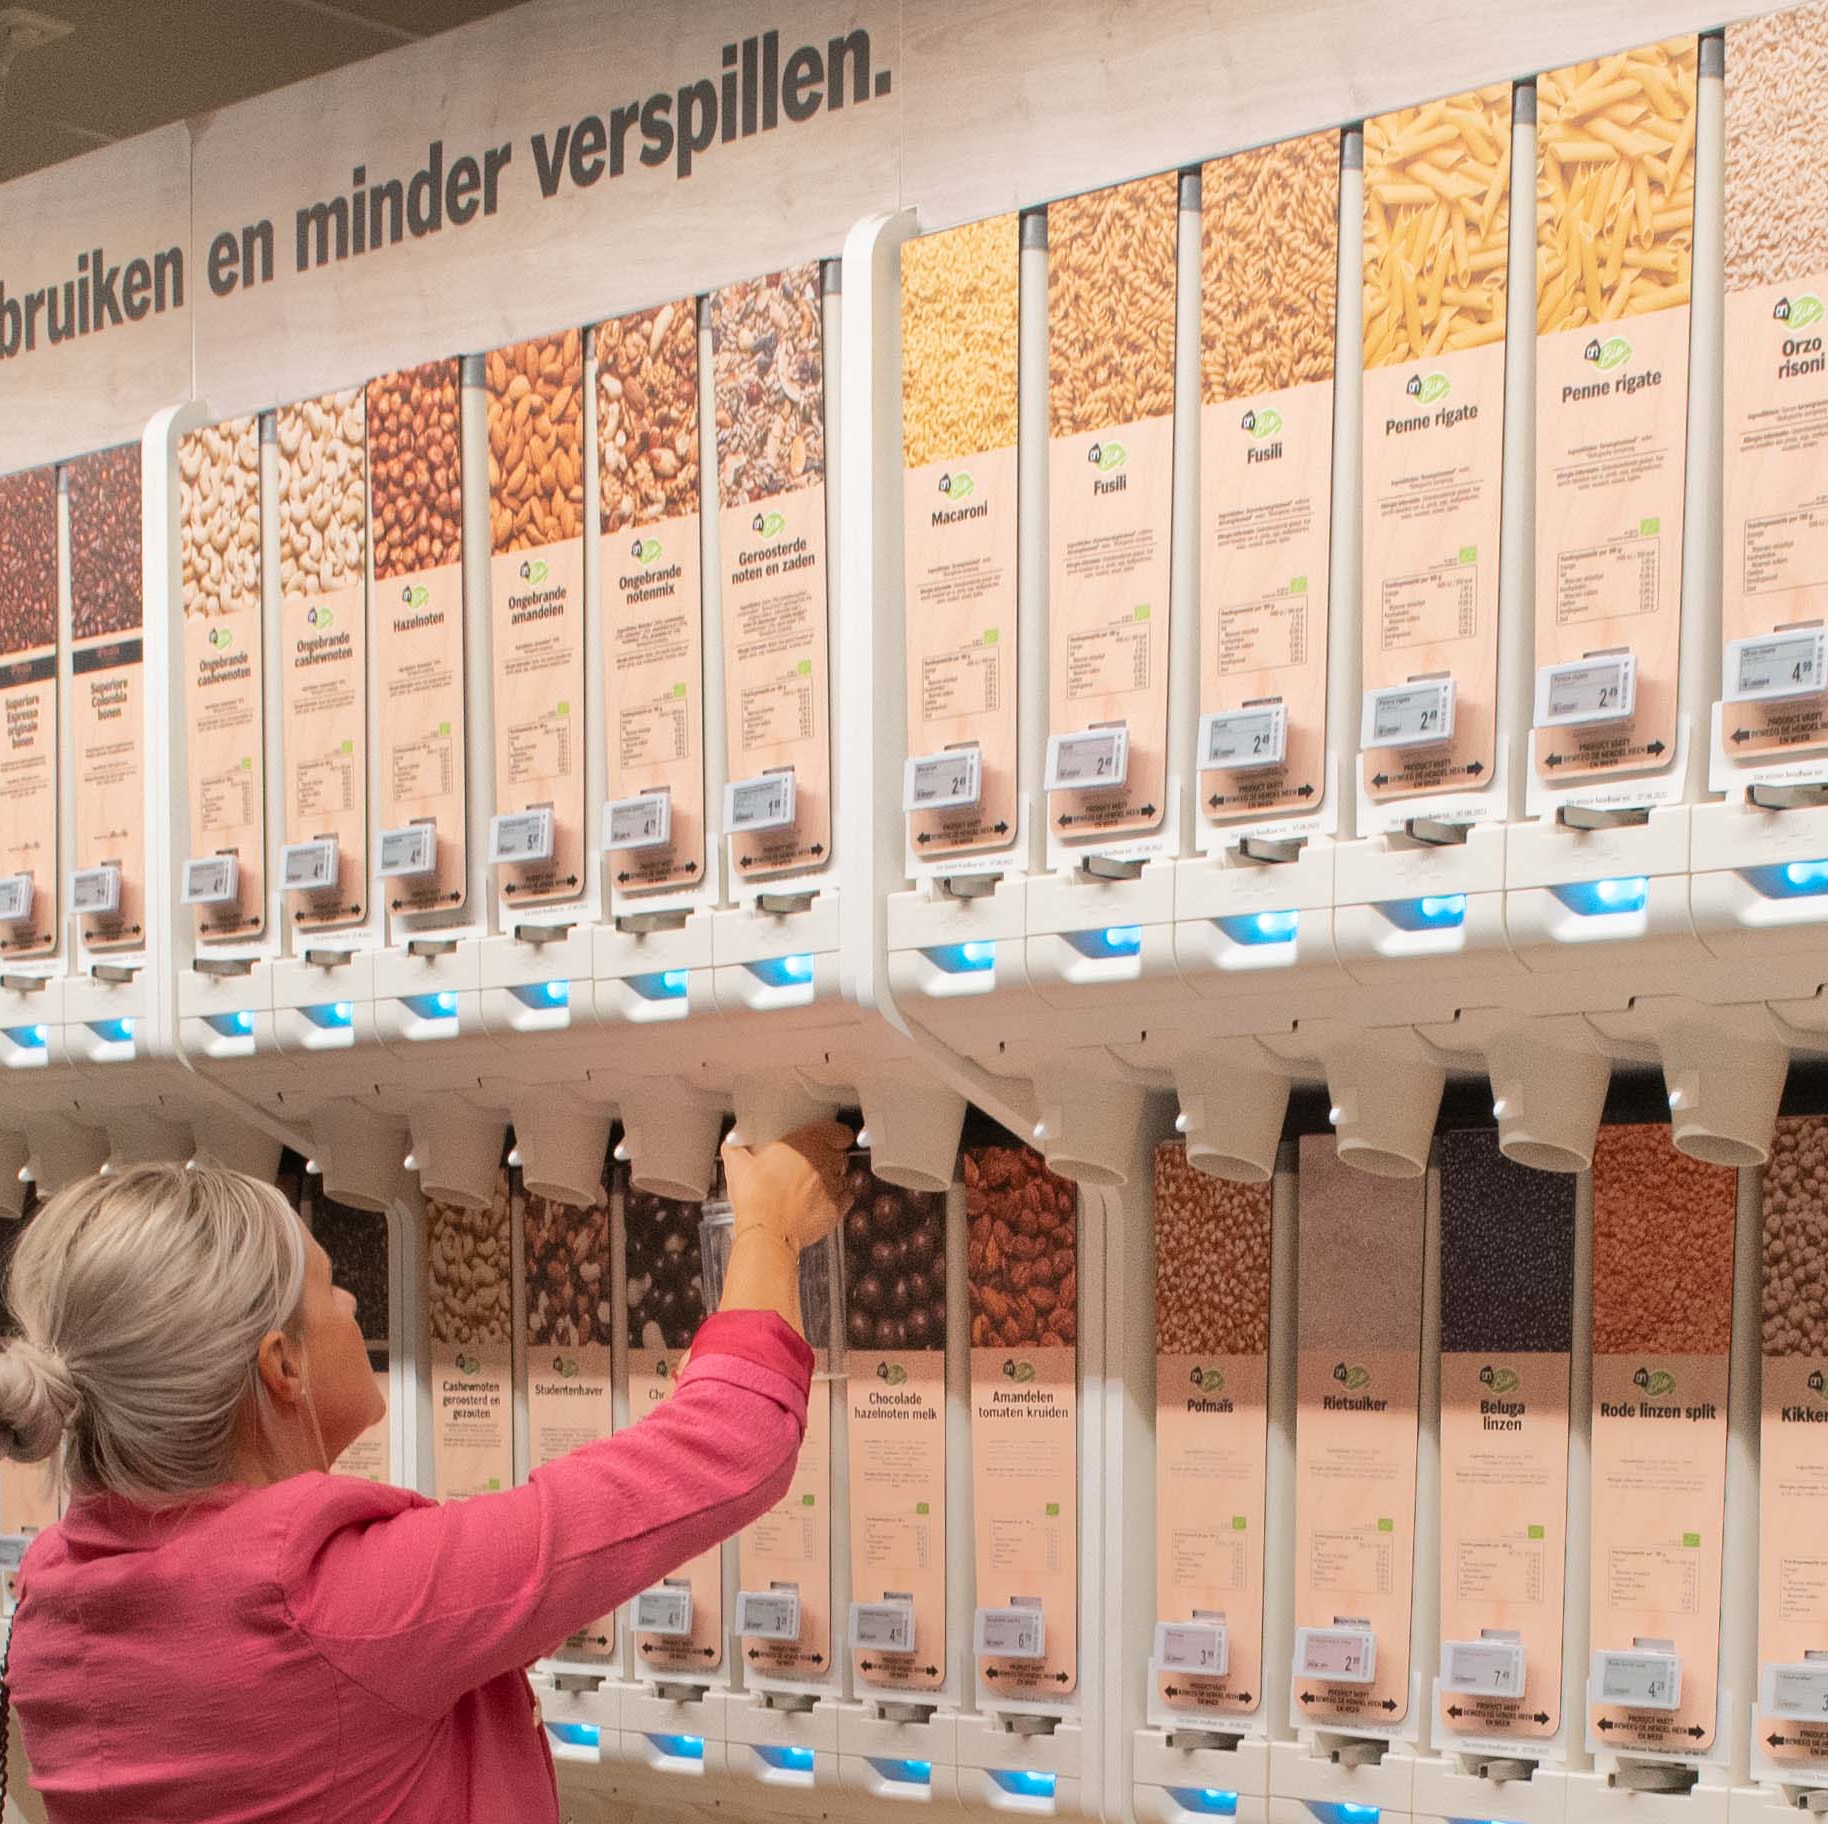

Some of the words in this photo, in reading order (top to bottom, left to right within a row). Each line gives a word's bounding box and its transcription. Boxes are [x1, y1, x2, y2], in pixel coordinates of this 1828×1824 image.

[206, 216, 274, 298] en
[295, 138, 512, 274] minder
[530, 25, 892, 195] verspillen.
[1782, 335, 1822, 358] Orzo
[1778, 354, 1825, 379] risoni
[1562, 381, 1610, 403] Penne
[1615, 369, 1661, 393] rigate
[1385, 414, 1430, 435] Penne
[1435, 404, 1478, 428] rigate
[1247, 442, 1283, 464] Fusili
[1093, 474, 1127, 496] Fusili
[931, 503, 988, 527] Macaroni
[739, 537, 806, 566] Geroosterde
[618, 564, 682, 590] Ongebrande
[732, 566, 762, 584] noten
[766, 561, 778, 576] en
[782, 554, 815, 572] zaden
[508, 586, 566, 610] Ongebrande
[625, 581, 675, 605] notenmix
[392, 611, 444, 632] Hazelnoten
[510, 602, 564, 623] amandelen
[296, 631, 350, 654] Ongebrande
[294, 646, 353, 668] cashewnoten
[443, 1381, 499, 1392] Cashewnoten
[536, 1384, 604, 1396] Studentenhaver
[993, 1390, 1053, 1403] Amandelen
[443, 1395, 487, 1407] geroosterd
[869, 1392, 922, 1405] Chocolade
[1323, 1397, 1387, 1413] Rietsuiker
[1480, 1400, 1525, 1417] Beluga
[453, 1408, 490, 1420] gezouten
[855, 1407, 909, 1420] hazelnoten
[913, 1408, 937, 1420] melk
[979, 1407, 1023, 1418] tomaten
[1027, 1406, 1068, 1418] kruiden
[1601, 1403, 1635, 1417] Rode
[1639, 1403, 1681, 1419] linzen
[1684, 1404, 1716, 1423] split
[1483, 1417, 1522, 1432] linzen
